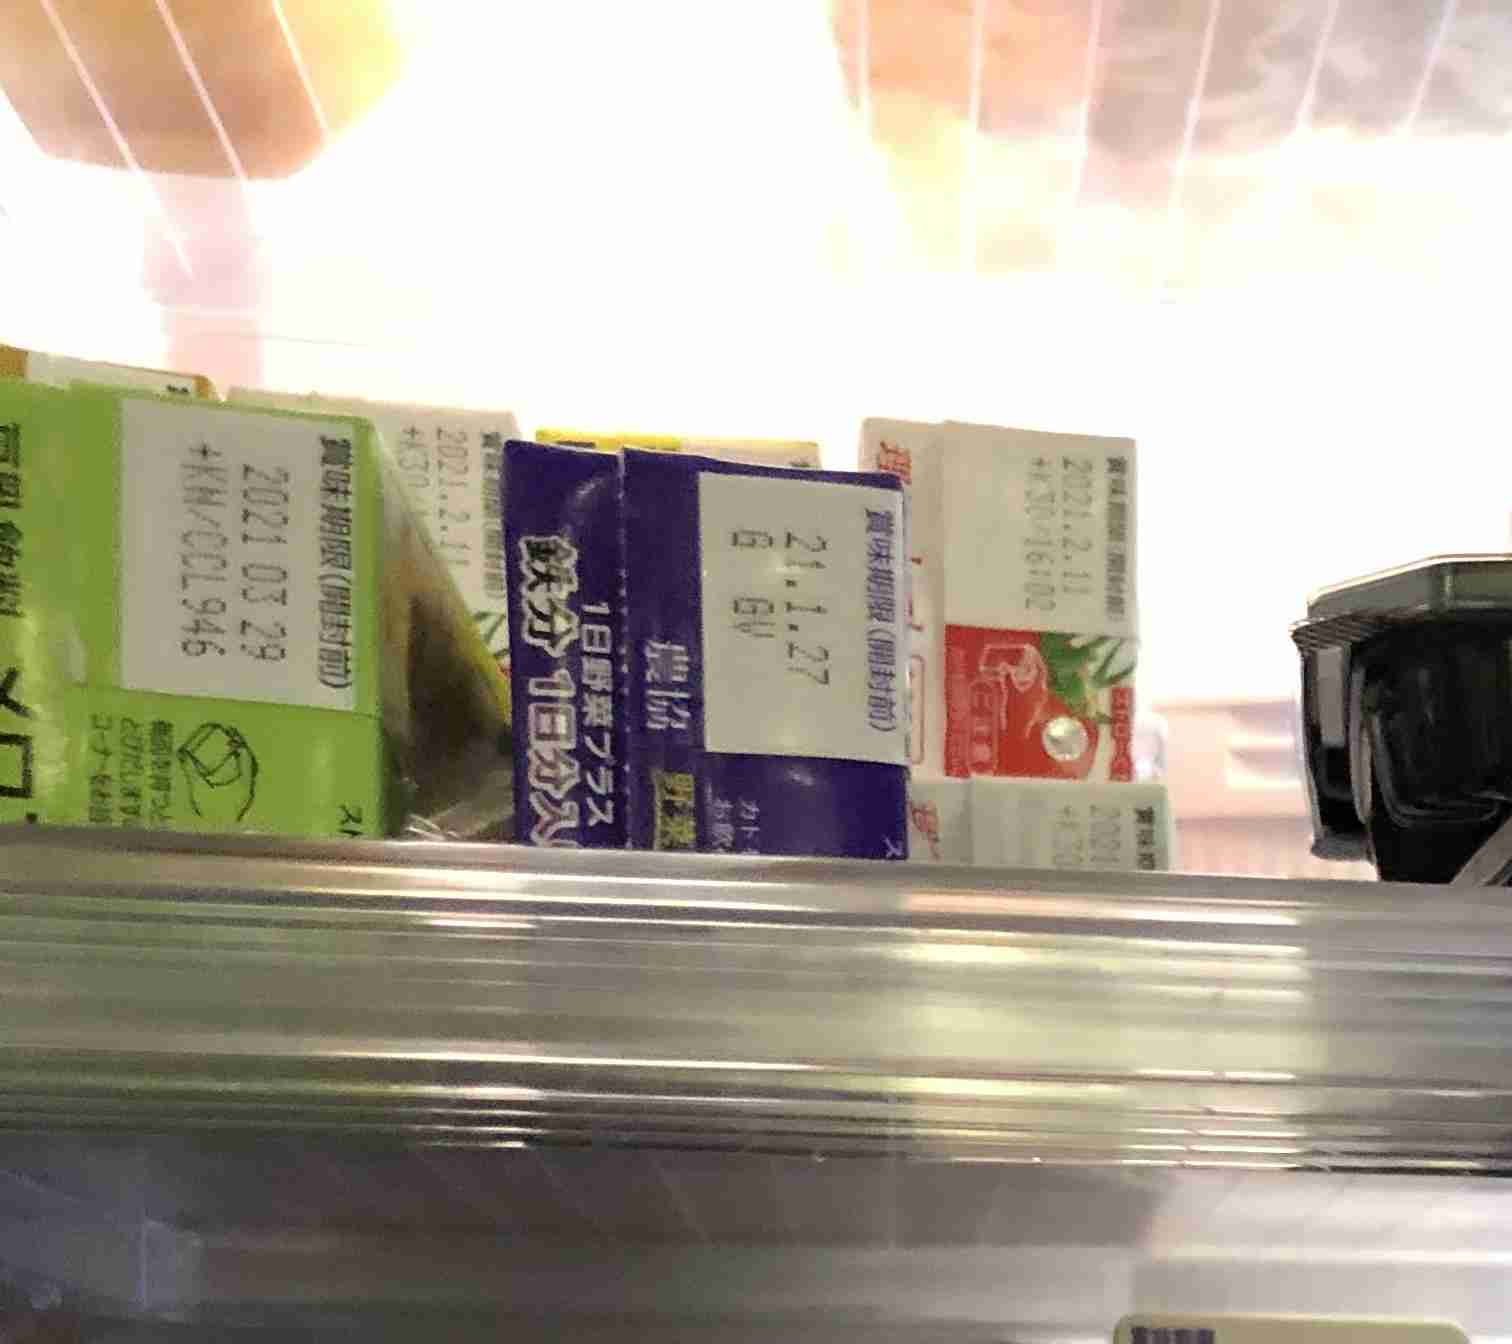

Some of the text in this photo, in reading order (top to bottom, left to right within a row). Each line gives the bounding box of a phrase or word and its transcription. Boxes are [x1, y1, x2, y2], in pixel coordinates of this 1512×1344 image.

[238, 463, 289, 664] 2021 03 29
[318, 435, 353, 689] 賞味期限(開封前)
[517, 534, 581, 657] 鉄分
[783, 528, 831, 687] 21.1.27
[1061, 454, 1096, 598] 2021.2.11
[645, 637, 692, 733] 農協
[864, 507, 897, 737] 賞味期限(開封前)
[580, 600, 615, 829] 1日野菜プラス
